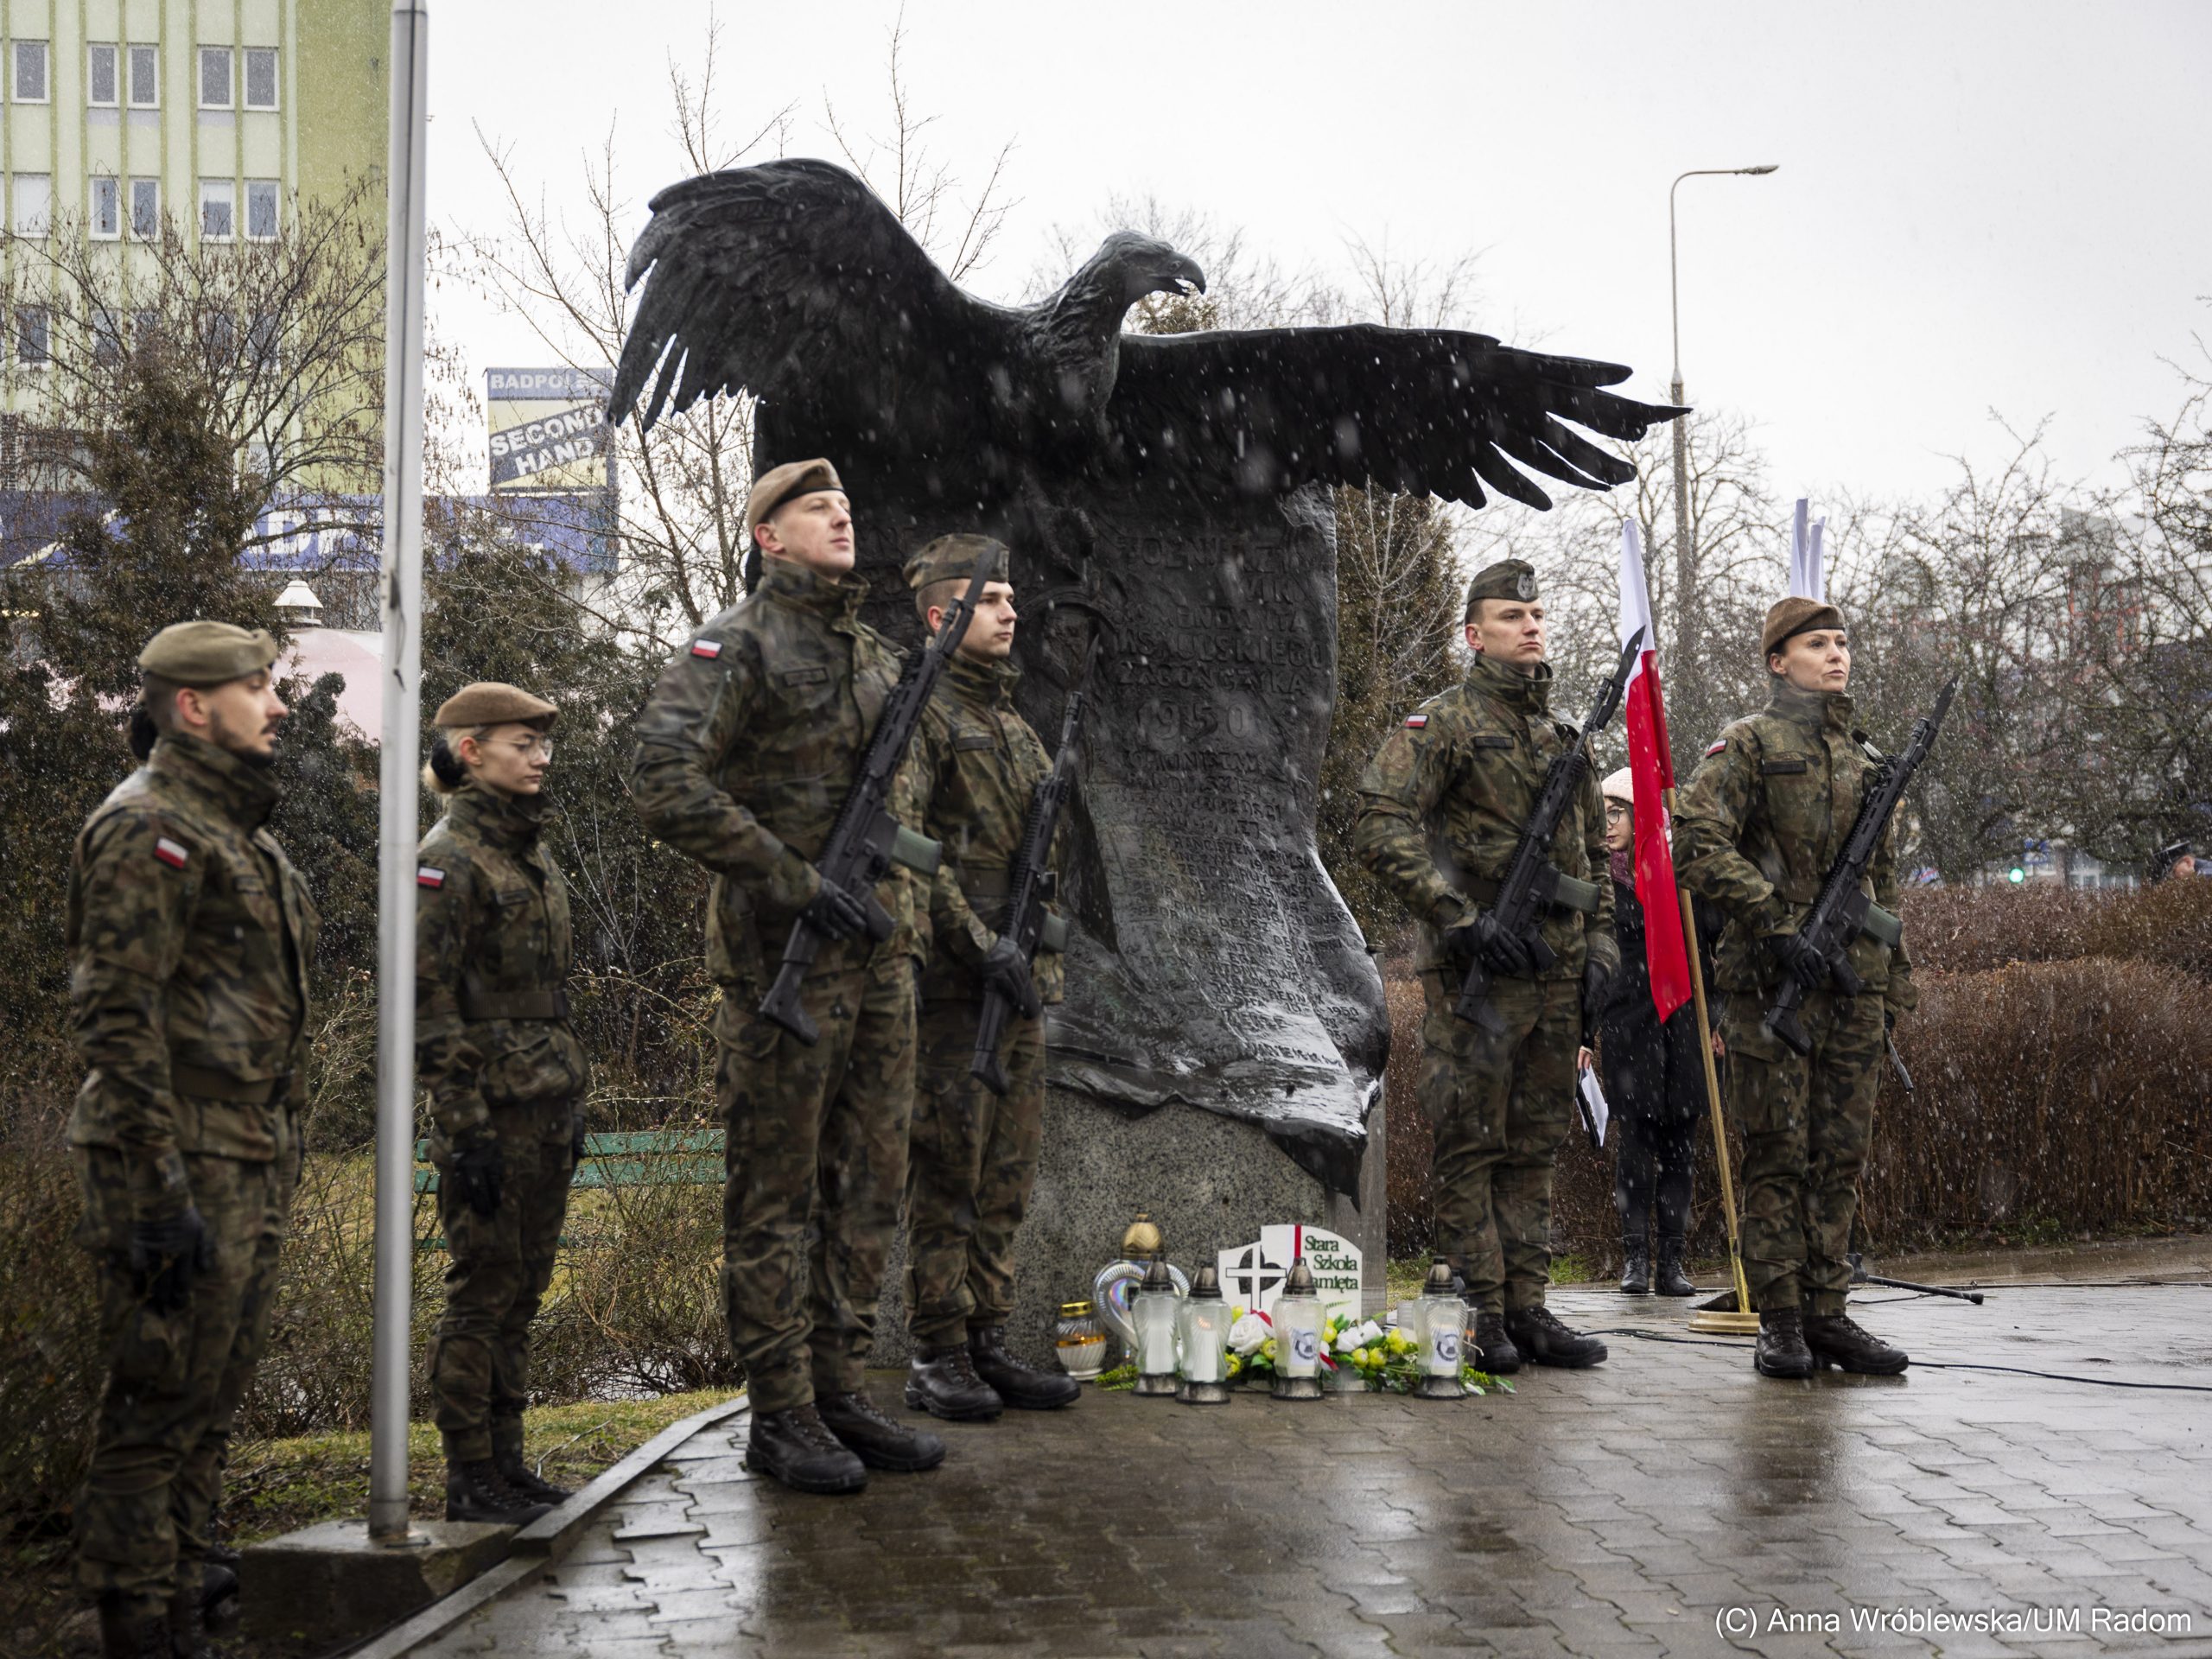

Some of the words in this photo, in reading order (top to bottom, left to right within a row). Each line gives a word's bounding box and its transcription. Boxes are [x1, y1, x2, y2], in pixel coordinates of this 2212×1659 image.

[490, 406, 603, 456] SECOND
[515, 436, 594, 476] HAND
[1304, 1236, 1339, 1252] Stara
[1312, 1274, 1358, 1294] amięta
